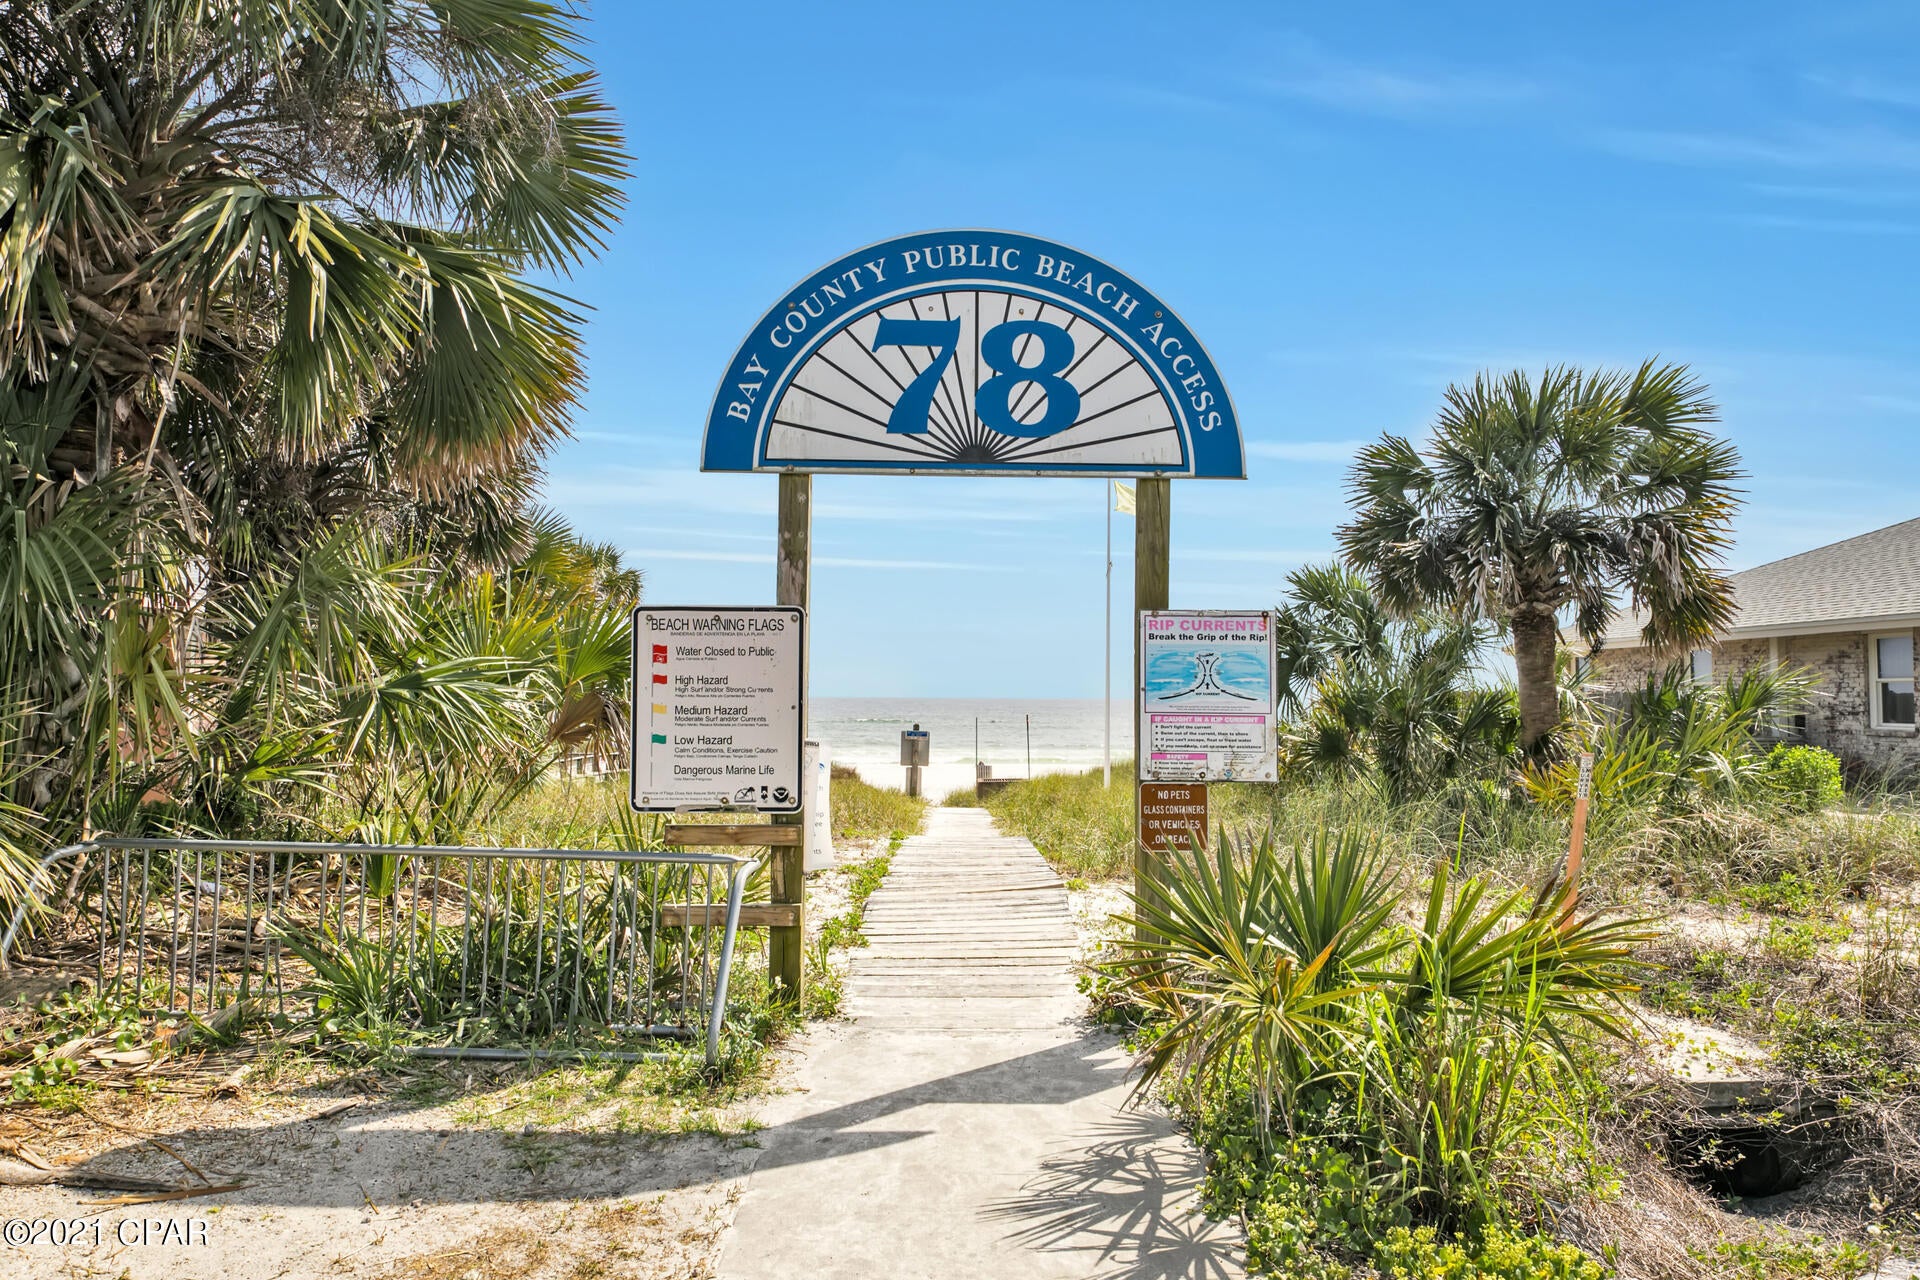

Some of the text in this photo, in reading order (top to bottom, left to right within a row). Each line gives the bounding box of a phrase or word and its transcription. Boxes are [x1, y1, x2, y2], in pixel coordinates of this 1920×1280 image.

[726, 244, 1222, 433] BAY COUNTY PUBLIC BEACH ACCESS
[871, 314, 1082, 438] 78
[652, 618, 784, 631] BEACH WARNING FLAGS
[1148, 620, 1267, 631] RIP CURRENTS
[1197, 633, 1215, 642] Grip
[1250, 634, 1267, 642] Rip!
[676, 647, 774, 656] Water Closed to Public
[675, 675, 728, 686] High Hazard
[675, 706, 748, 715] Medium Hazard
[674, 736, 733, 744] Low Hazard
[674, 765, 774, 777] Dangerous Marine Life
[1158, 791, 1190, 799] NO PETS
[1144, 805, 1205, 814] GLASS CONTAINERS
[1149, 820, 1160, 829] OR
